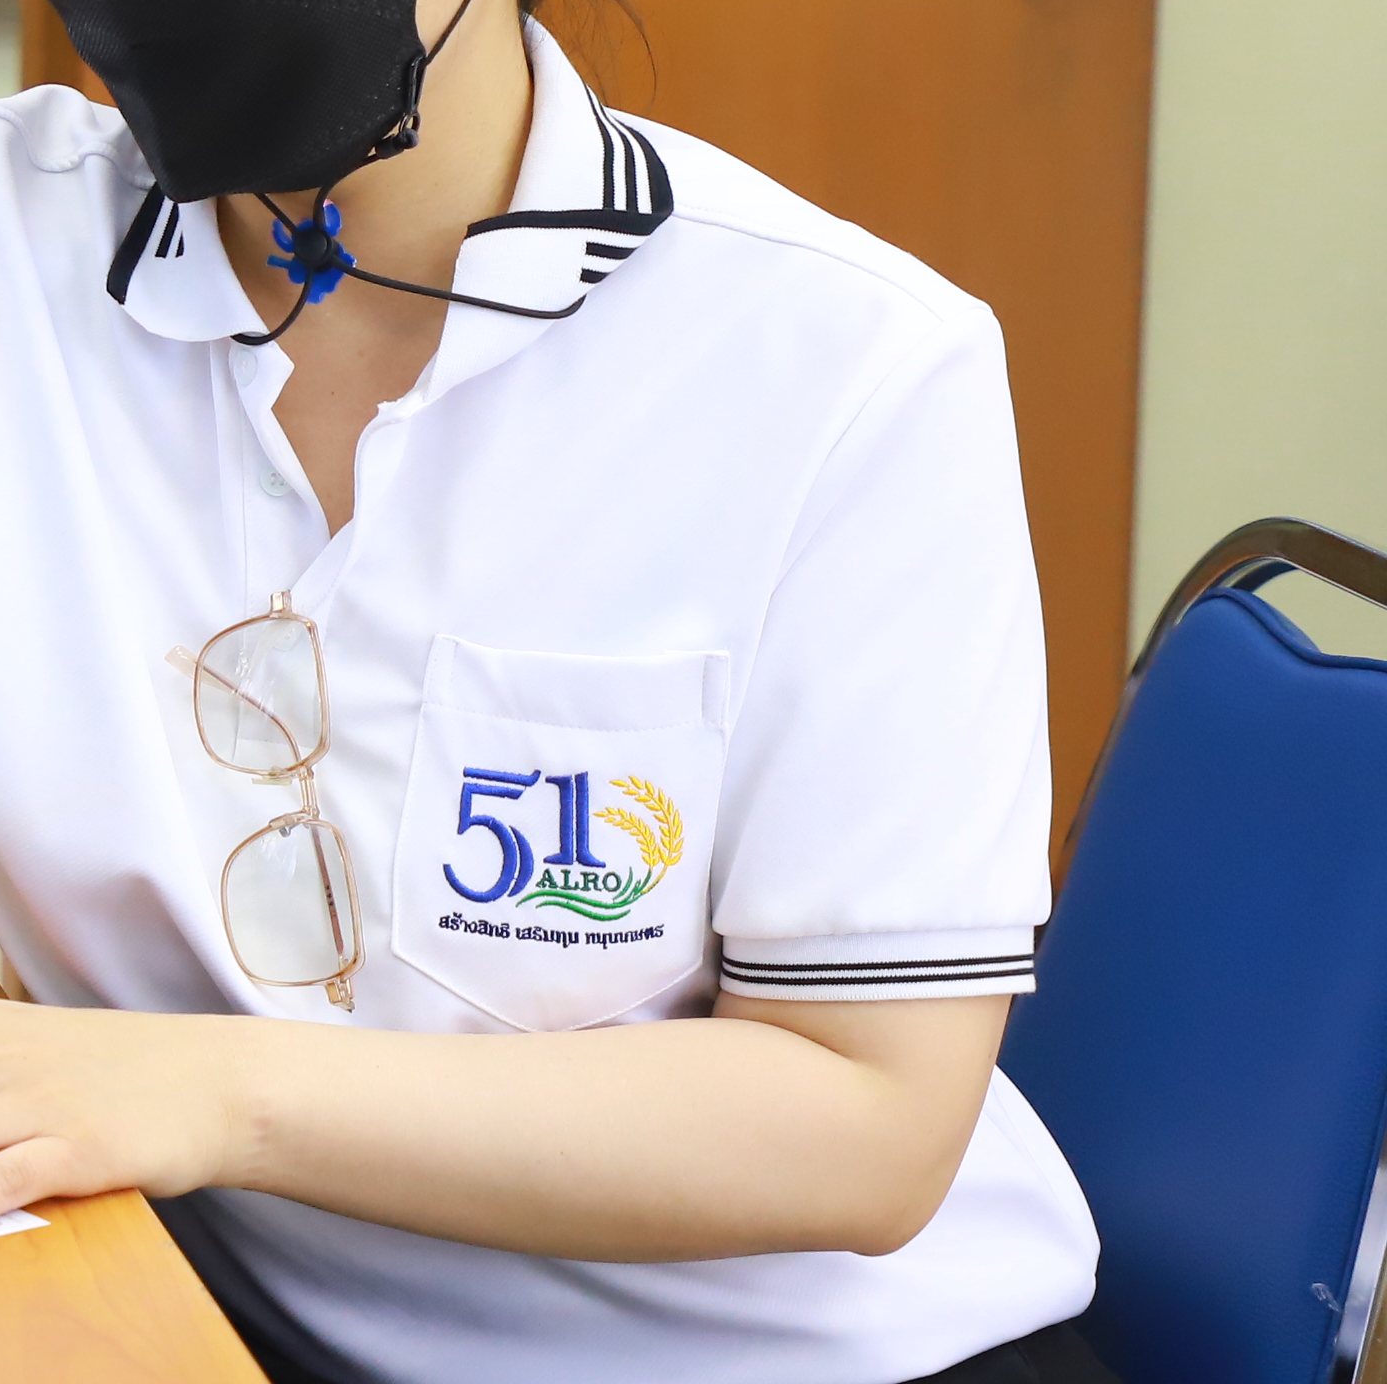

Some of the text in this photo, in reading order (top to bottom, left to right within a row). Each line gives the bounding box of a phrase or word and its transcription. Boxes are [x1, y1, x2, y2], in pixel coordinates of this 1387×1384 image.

[443, 767, 606, 903] 51
[536, 868, 622, 893] ALRO
[439, 912, 510, 939] สร้างสิทธิ
[515, 926, 579, 948] เสริมทุน
